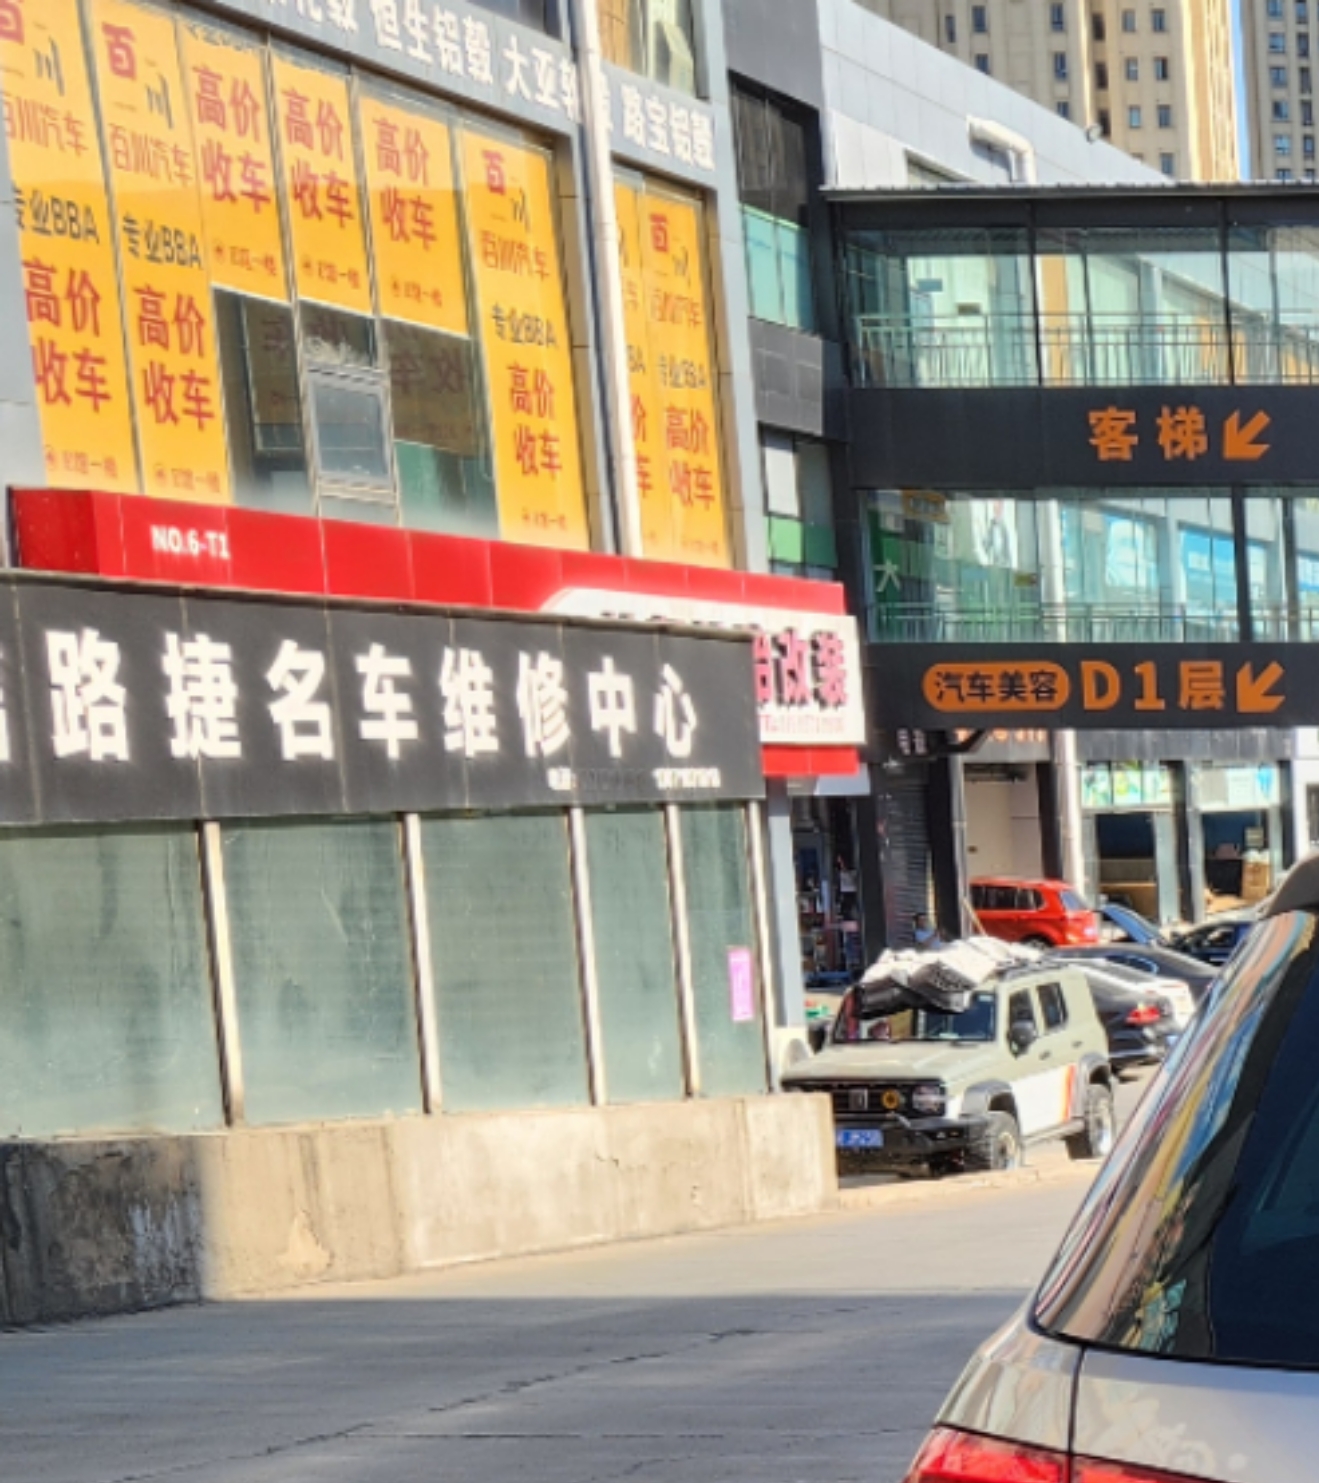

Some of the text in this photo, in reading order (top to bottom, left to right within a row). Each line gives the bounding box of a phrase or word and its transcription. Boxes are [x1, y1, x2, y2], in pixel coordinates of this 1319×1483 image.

[192, 64, 262, 144] 高价
[280, 87, 344, 162] 高价
[200, 138, 272, 215] 收车
[372, 116, 430, 187] 高价
[291, 159, 355, 229] 收车
[379, 186, 438, 252] 收车
[21, 256, 102, 338] 高价
[133, 284, 206, 358] 高价
[30, 336, 113, 413] 收车
[143, 360, 216, 432] 收车
[507, 361, 556, 420] 高价
[514, 423, 563, 480] 收车
[665, 402, 710, 456] 高价
[1087, 406, 1210, 461] 客梯
[669, 459, 716, 512] 收车
[150, 524, 231, 561] NO.6-T1
[0, 627, 698, 762] 路捷名车维修中心
[935, 670, 1058, 703] 汽车美容
